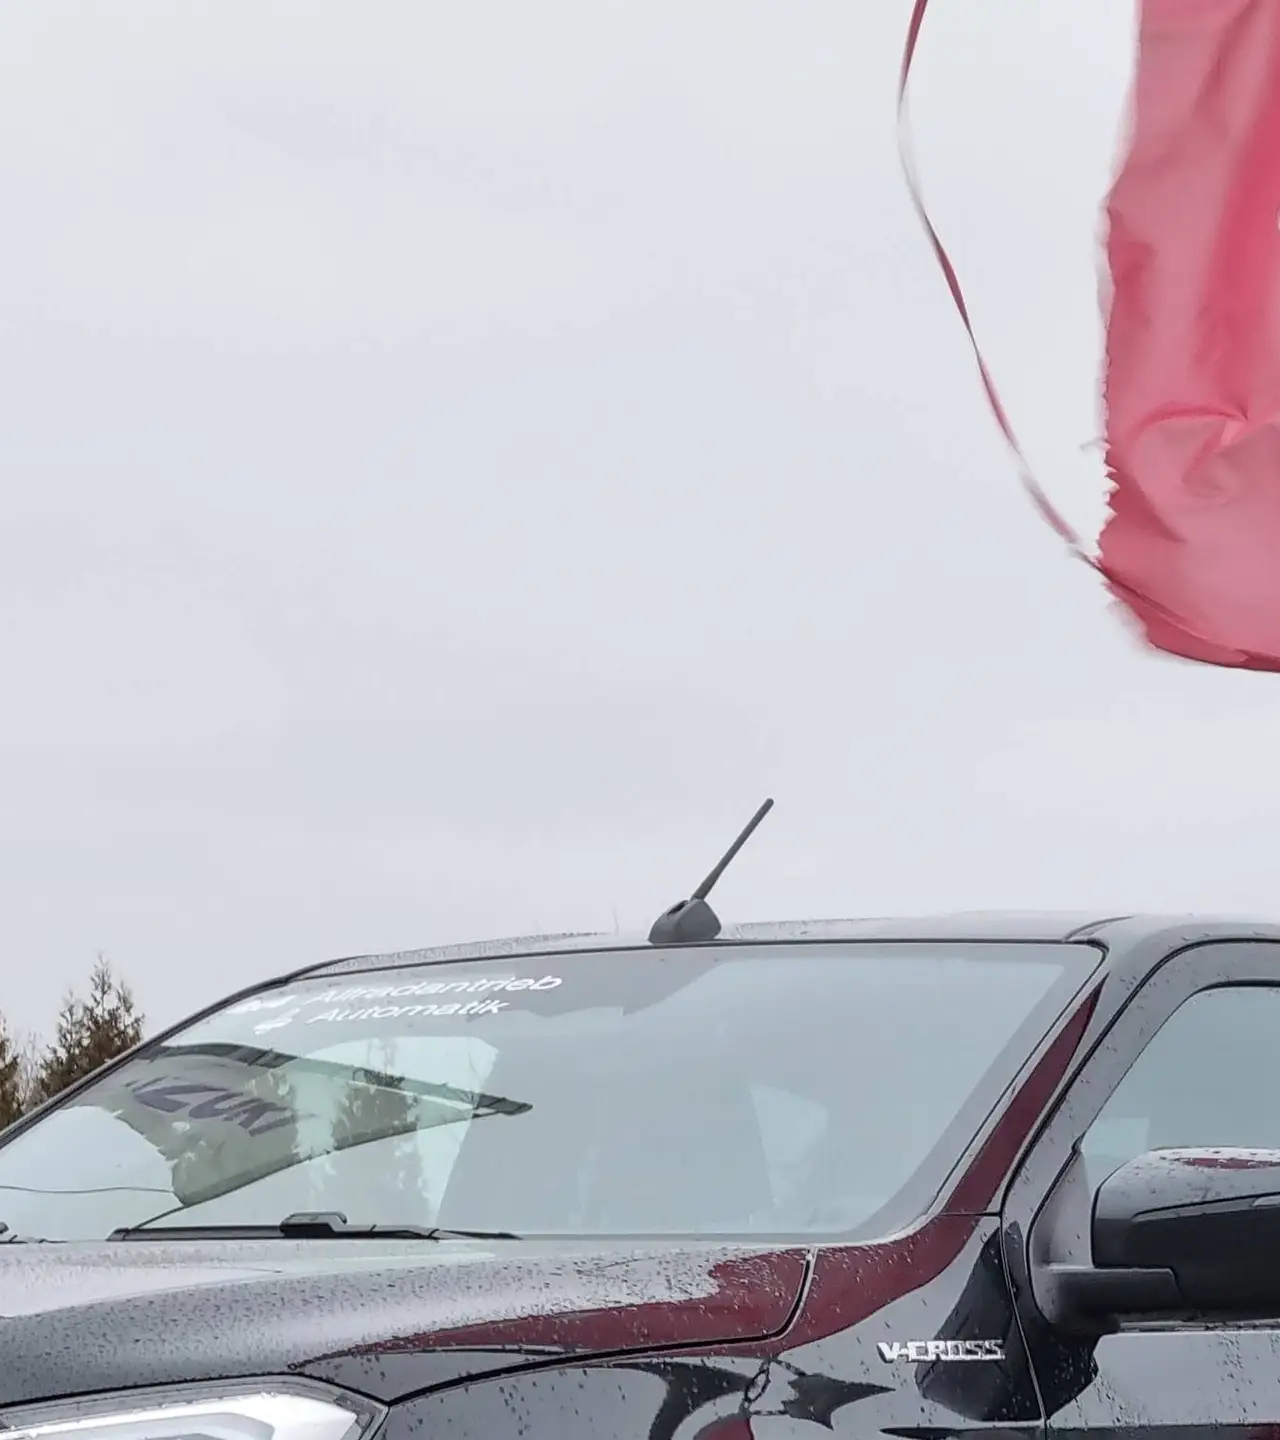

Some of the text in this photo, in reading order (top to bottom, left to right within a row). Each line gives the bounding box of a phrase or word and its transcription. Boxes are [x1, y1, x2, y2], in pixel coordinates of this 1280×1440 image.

[300, 975, 563, 1005] Allradantrieb
[305, 998, 509, 1024] Automatik
[876, 1339, 1006, 1363] V-CROSS
